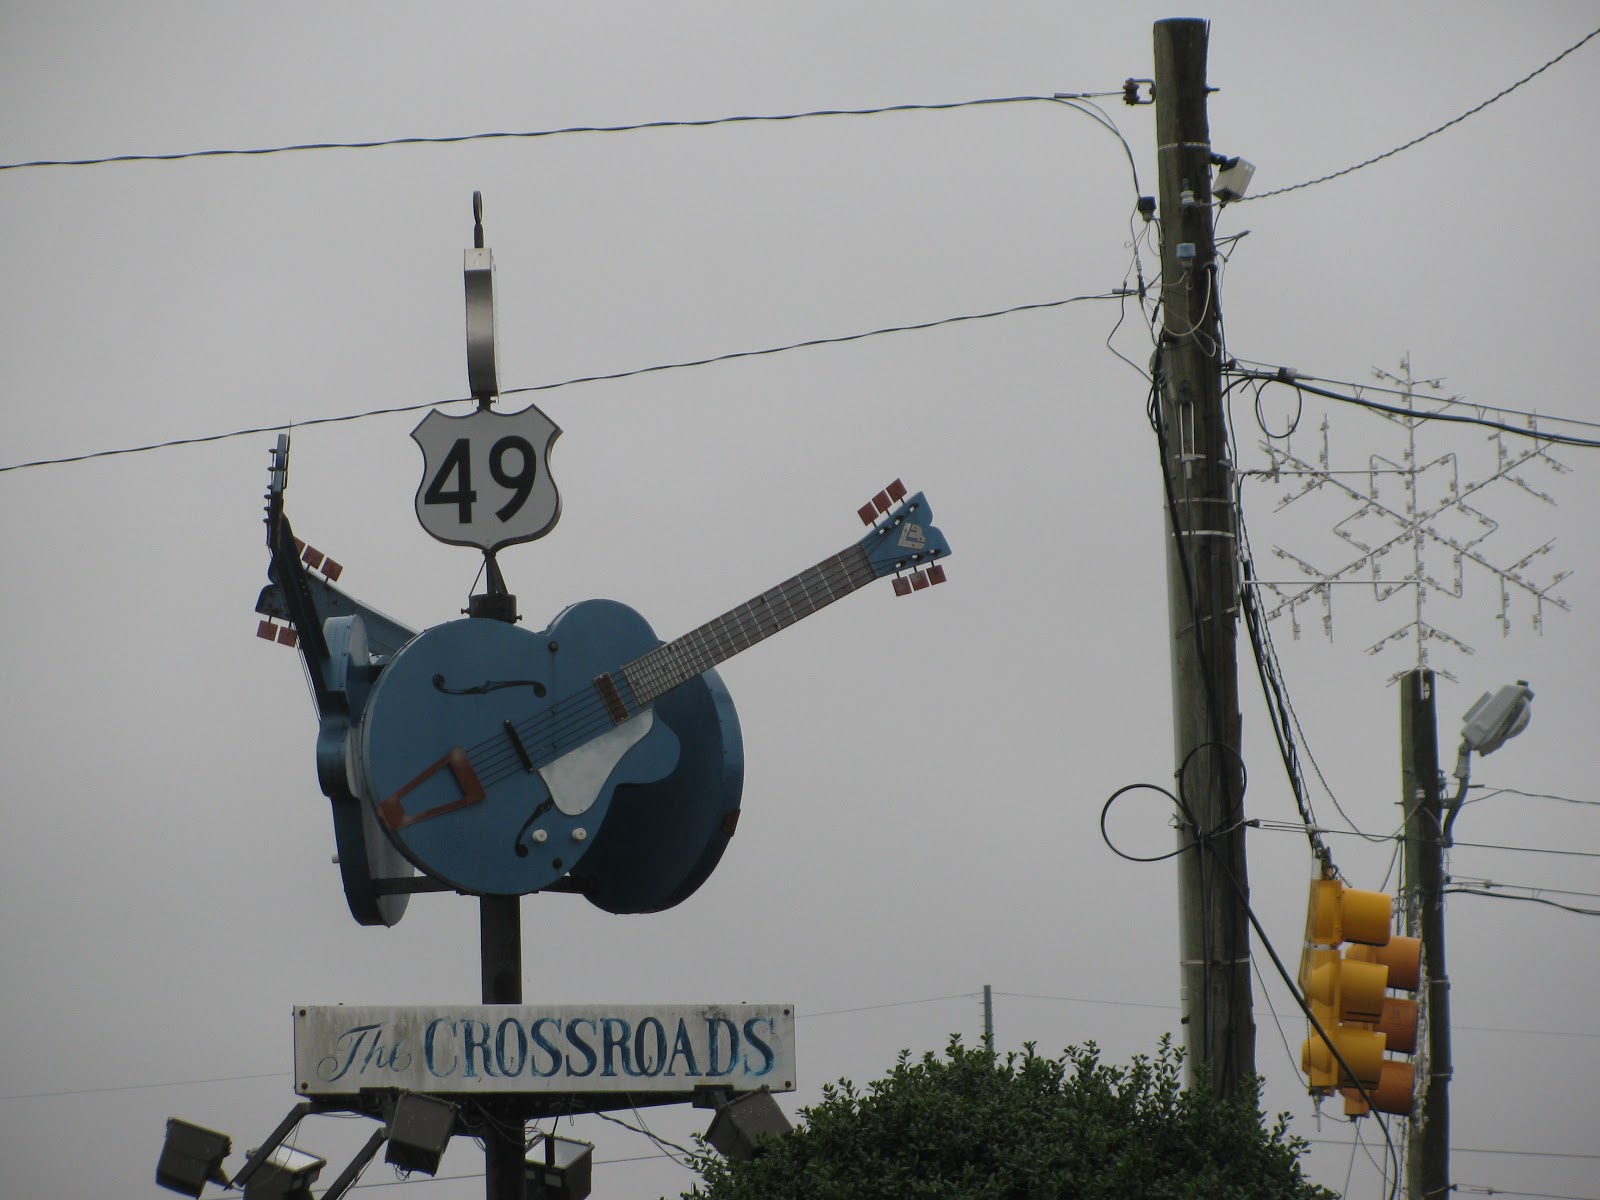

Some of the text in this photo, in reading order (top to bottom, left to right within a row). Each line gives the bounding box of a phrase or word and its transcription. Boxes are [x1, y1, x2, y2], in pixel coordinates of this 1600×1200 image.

[424, 435, 537, 524] 49
[316, 1016, 776, 1083] The CROSSROADS
